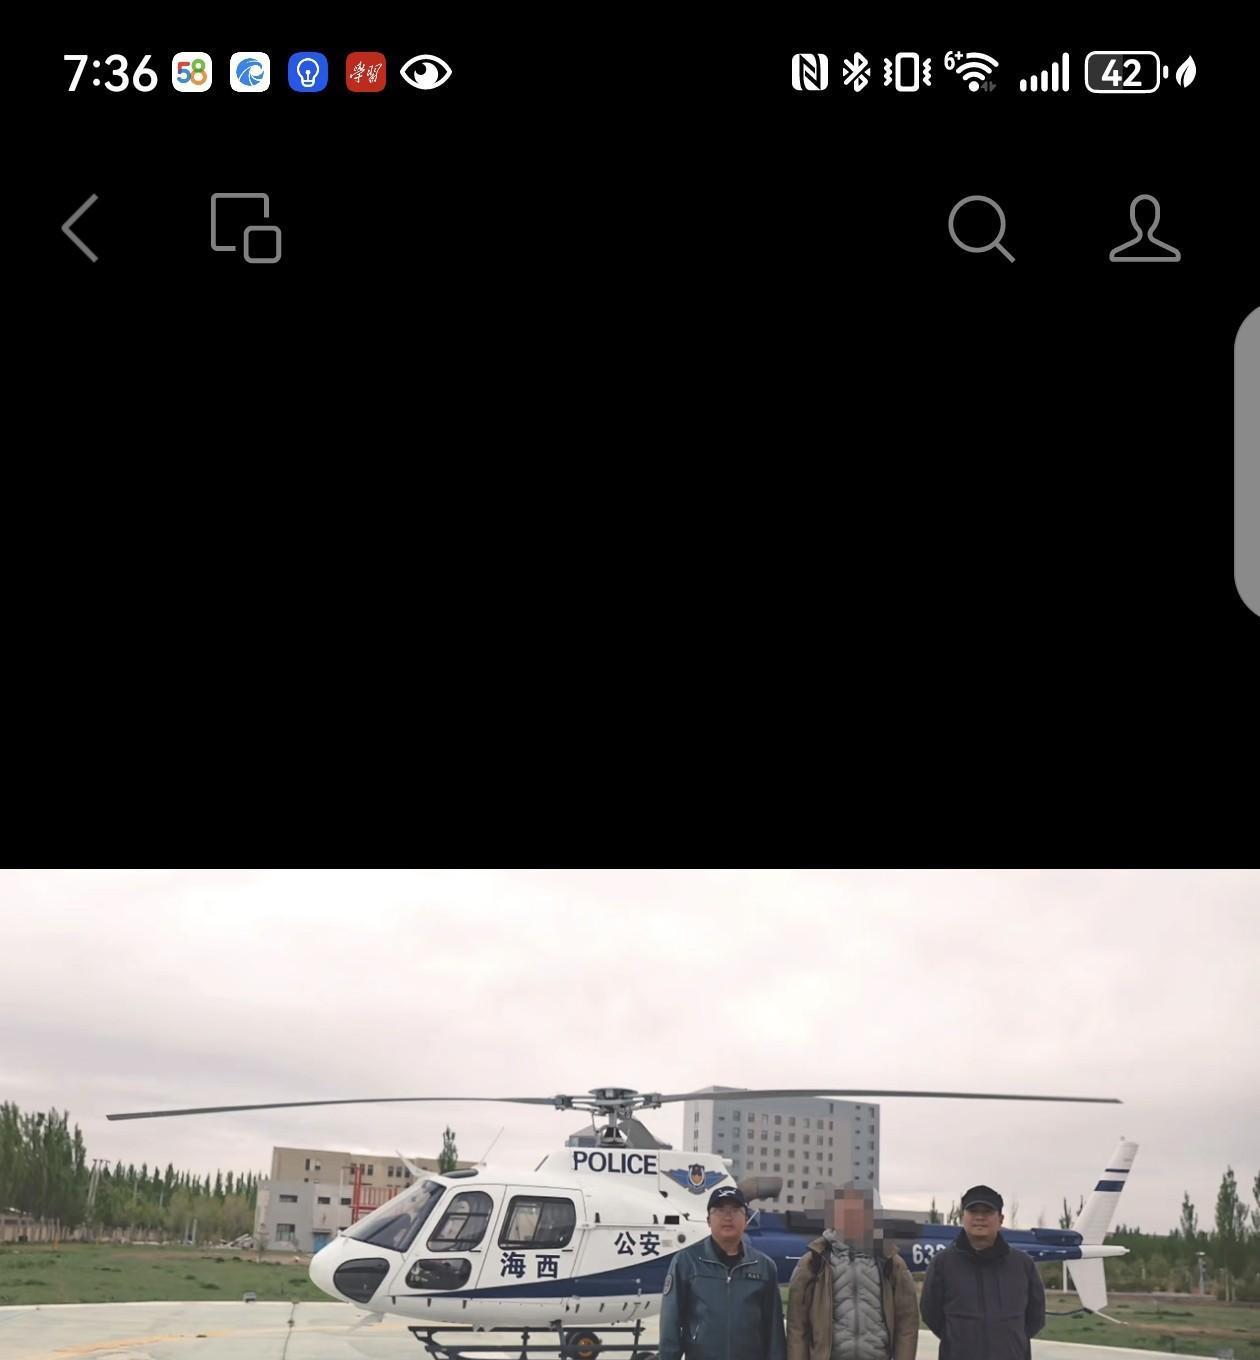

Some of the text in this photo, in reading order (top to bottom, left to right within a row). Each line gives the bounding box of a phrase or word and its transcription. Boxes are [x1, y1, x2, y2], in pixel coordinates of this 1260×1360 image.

[64, 54, 158, 92] 7:36
[177, 58, 208, 86] 58
[1101, 58, 1142, 87] 42
[573, 1151, 657, 1175] POLICE
[501, 1231, 661, 1279] 海西 公安
